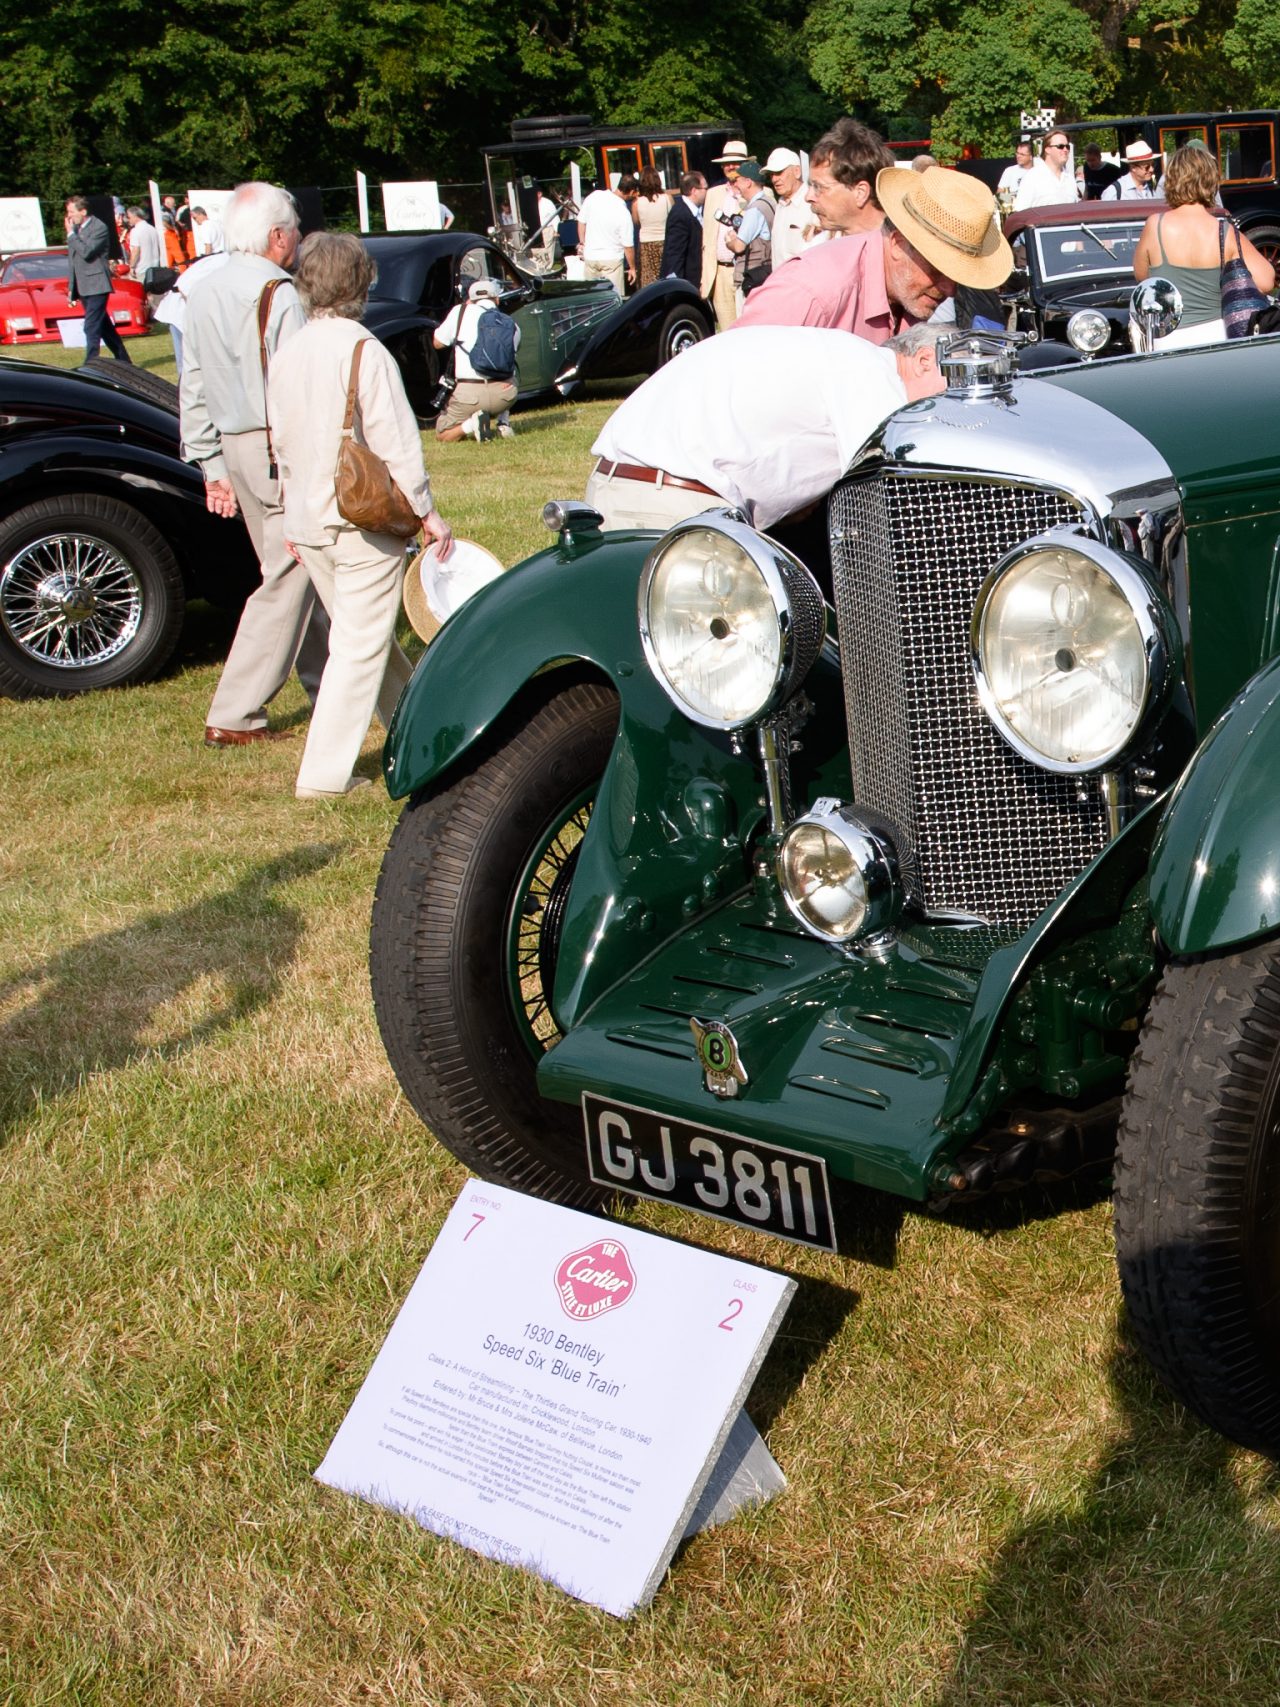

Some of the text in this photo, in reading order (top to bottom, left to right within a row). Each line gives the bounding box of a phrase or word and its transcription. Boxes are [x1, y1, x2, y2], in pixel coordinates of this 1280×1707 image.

[709, 1037, 725, 1065] B
[598, 1111, 817, 1237] GJ 3811
[463, 1213, 486, 1241] 7
[602, 1243, 620, 1258] THE
[567, 1255, 629, 1292] Cartier
[732, 1279, 759, 1293] CLASS
[562, 1281, 612, 1316] STYLE ET LUXE
[718, 1299, 741, 1331] 2
[482, 1334, 525, 1361] Speed
[524, 1350, 546, 1370] Six
[521, 1322, 605, 1368] 1930 Bentley
[428, 1353, 445, 1365] Class
[458, 1365, 473, 1376] Hint
[521, 1389, 534, 1400] The
[534, 1395, 558, 1410] Thirties
[558, 1404, 579, 1417] Grand
[579, 1412, 603, 1429] Touring
[433, 1380, 458, 1395] Entered
[468, 1393, 477, 1403] Mr
[476, 1397, 494, 1410] Bruce
[495, 1404, 501, 1412] &
[501, 1407, 513, 1417] Mrs
[598, 1445, 623, 1461] London
[468, 1381, 481, 1391] Car
[571, 1422, 596, 1437] London
[443, 1515, 455, 1525] DO
[468, 1526, 490, 1541] TOUCH
[490, 1536, 503, 1547] THE
